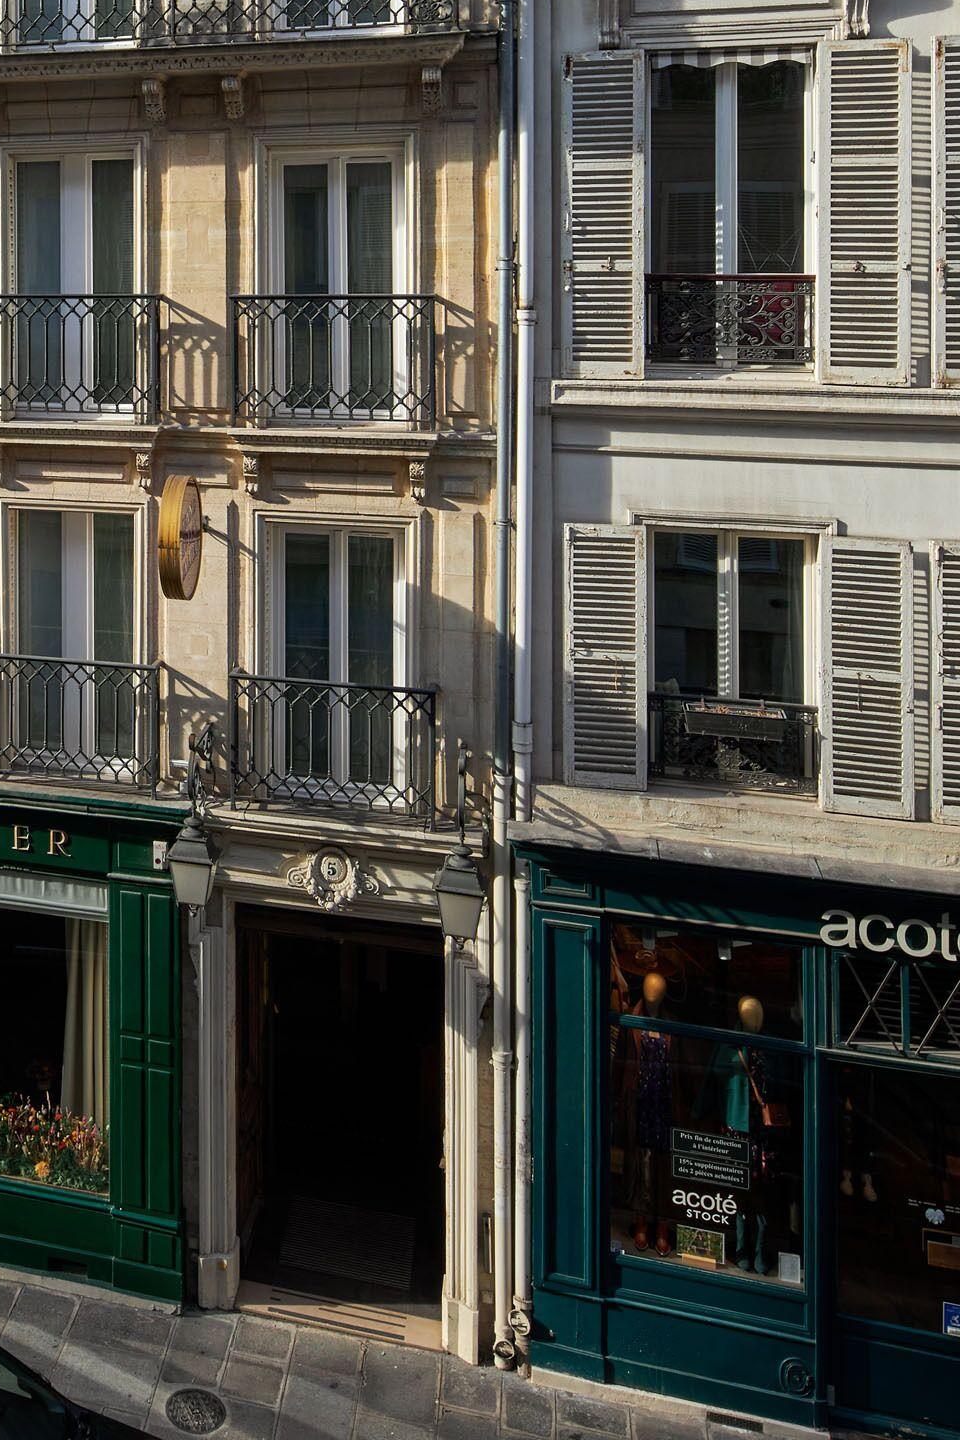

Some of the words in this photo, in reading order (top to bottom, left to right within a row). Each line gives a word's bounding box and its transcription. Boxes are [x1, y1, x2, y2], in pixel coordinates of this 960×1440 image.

[328, 862, 338, 876] 5
[819, 908, 960, 962] acot
[680, 1132, 693, 1140] Prix
[712, 1139, 742, 1148] collection
[679, 1158, 693, 1166] 15%
[694, 1161, 744, 1175] supplémentaires
[672, 1189, 737, 1215] acoté
[686, 1208, 729, 1225] STOCK
